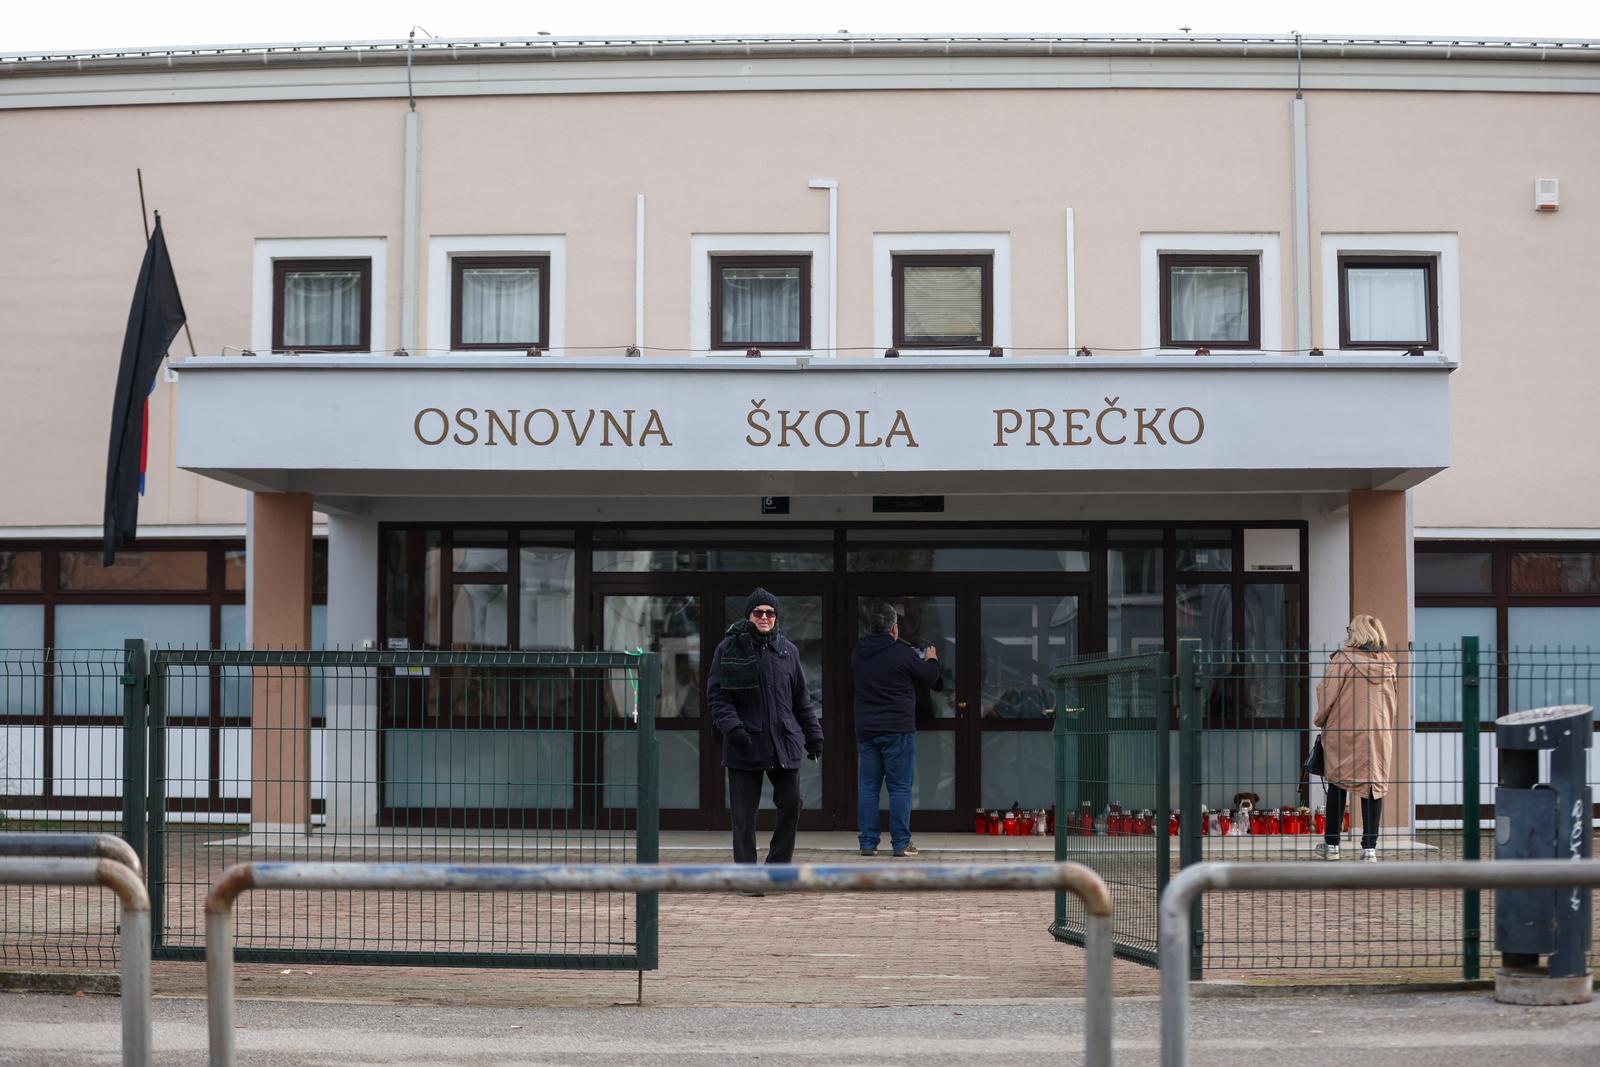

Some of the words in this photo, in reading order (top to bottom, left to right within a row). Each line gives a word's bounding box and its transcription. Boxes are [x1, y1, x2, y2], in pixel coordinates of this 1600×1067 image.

[414, 407, 672, 447] OSNOVNA
[746, 398, 918, 448] ŠKOLA
[993, 397, 1205, 447] PREČKO
[765, 496, 773, 506] 6
